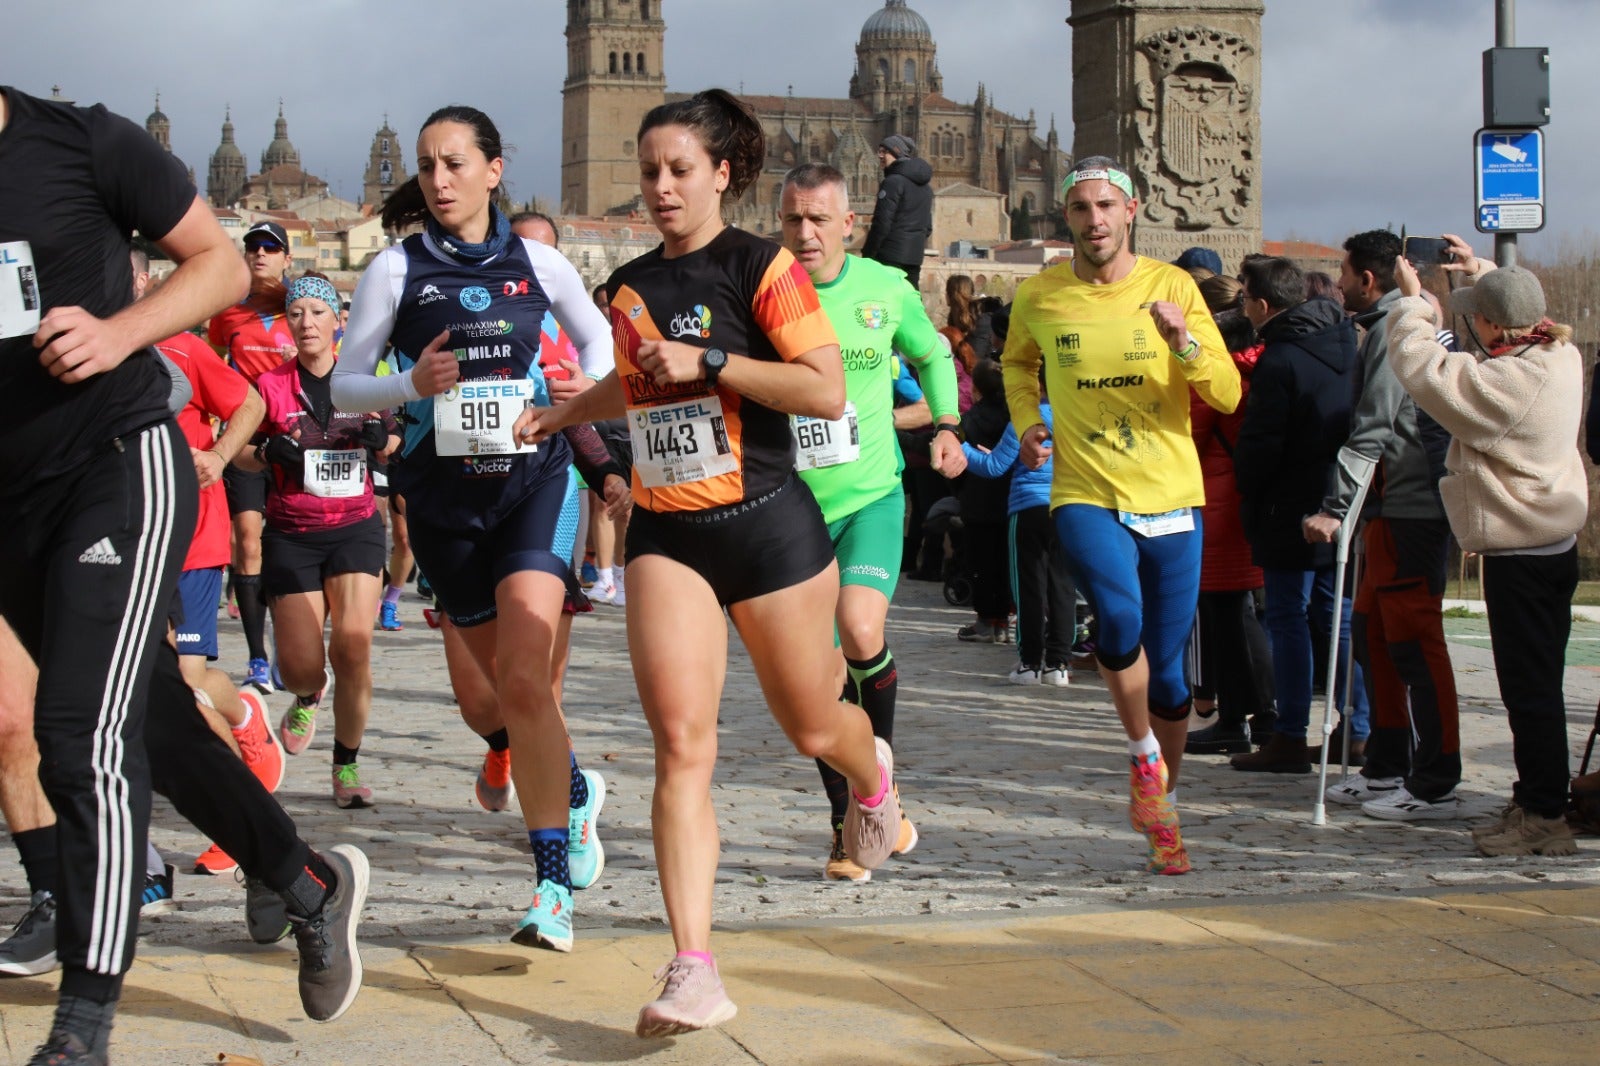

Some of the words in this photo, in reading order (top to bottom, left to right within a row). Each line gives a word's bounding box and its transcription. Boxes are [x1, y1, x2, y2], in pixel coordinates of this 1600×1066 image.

[466, 328, 504, 338] TELECOM
[468, 344, 512, 361] MILAR
[1124, 351, 1157, 361] SEGOVIA
[461, 385, 525, 399] SETEL
[461, 401, 500, 430] 919
[650, 404, 711, 425] SETEL
[646, 423, 699, 460] 1443
[797, 421, 832, 449] 661
[322, 452, 361, 461] SETEL
[315, 462, 351, 481] 1509
[473, 462, 512, 474] Victor
[78, 552, 122, 565] adidas
[176, 633, 201, 642] JAKO
